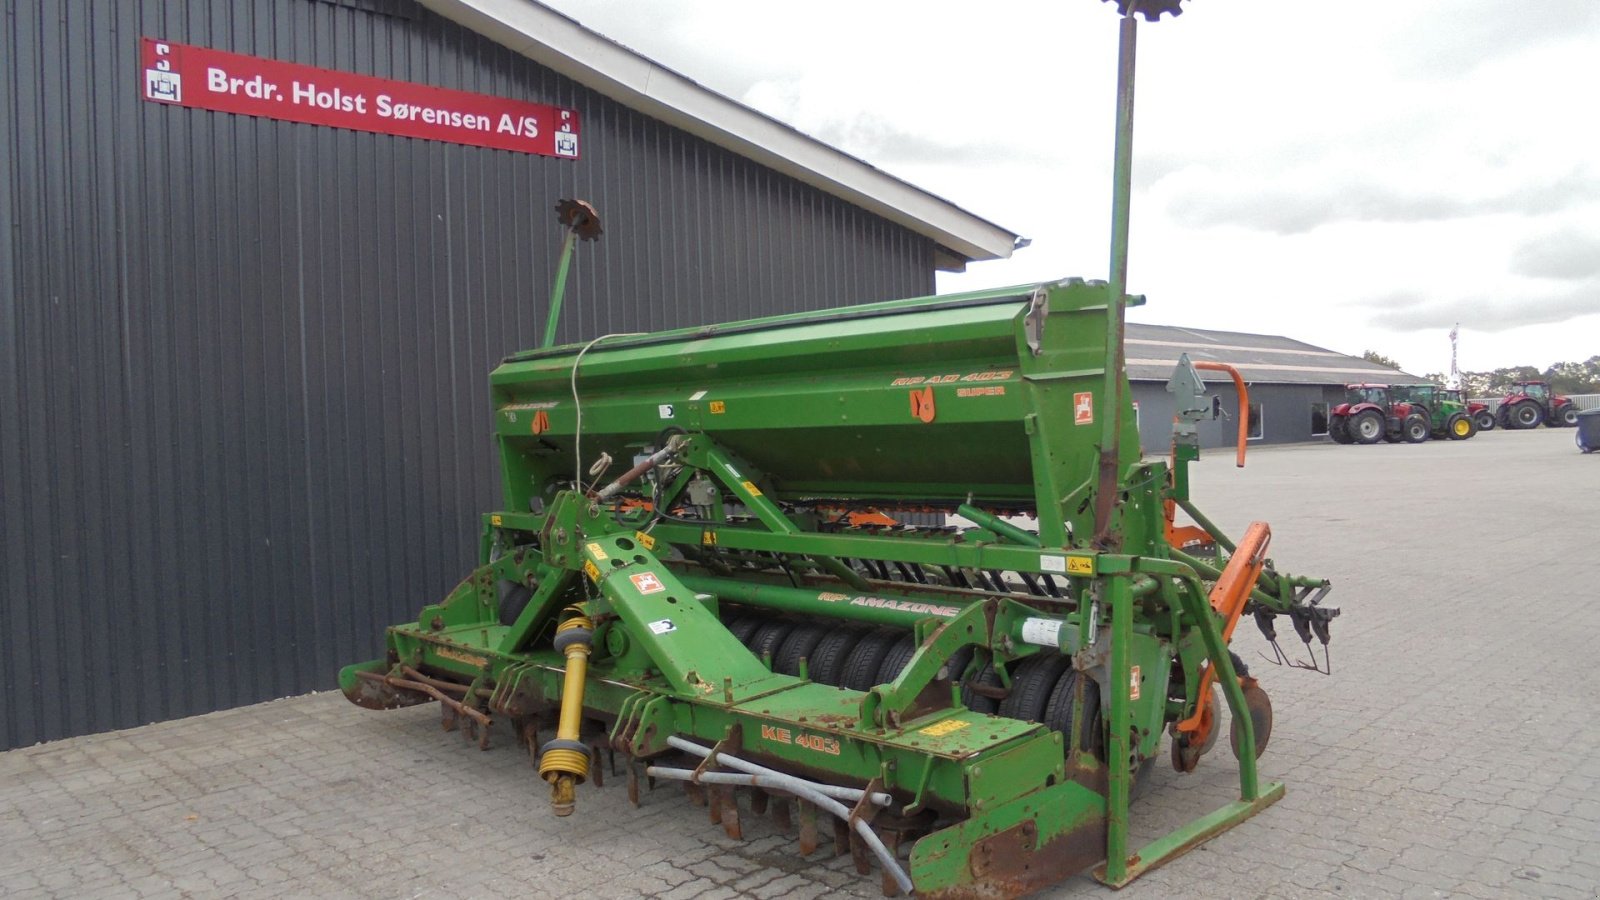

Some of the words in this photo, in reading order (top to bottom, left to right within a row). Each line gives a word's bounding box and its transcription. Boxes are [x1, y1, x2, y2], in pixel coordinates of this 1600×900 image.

[207, 67, 284, 102] Brdr.
[292, 80, 367, 114] Holst
[375, 94, 491, 131] Sørensen
[496, 112, 539, 139] A/S
[957, 386, 1006, 397] SUPER
[761, 724, 792, 744] KE
[795, 733, 841, 756] 403
